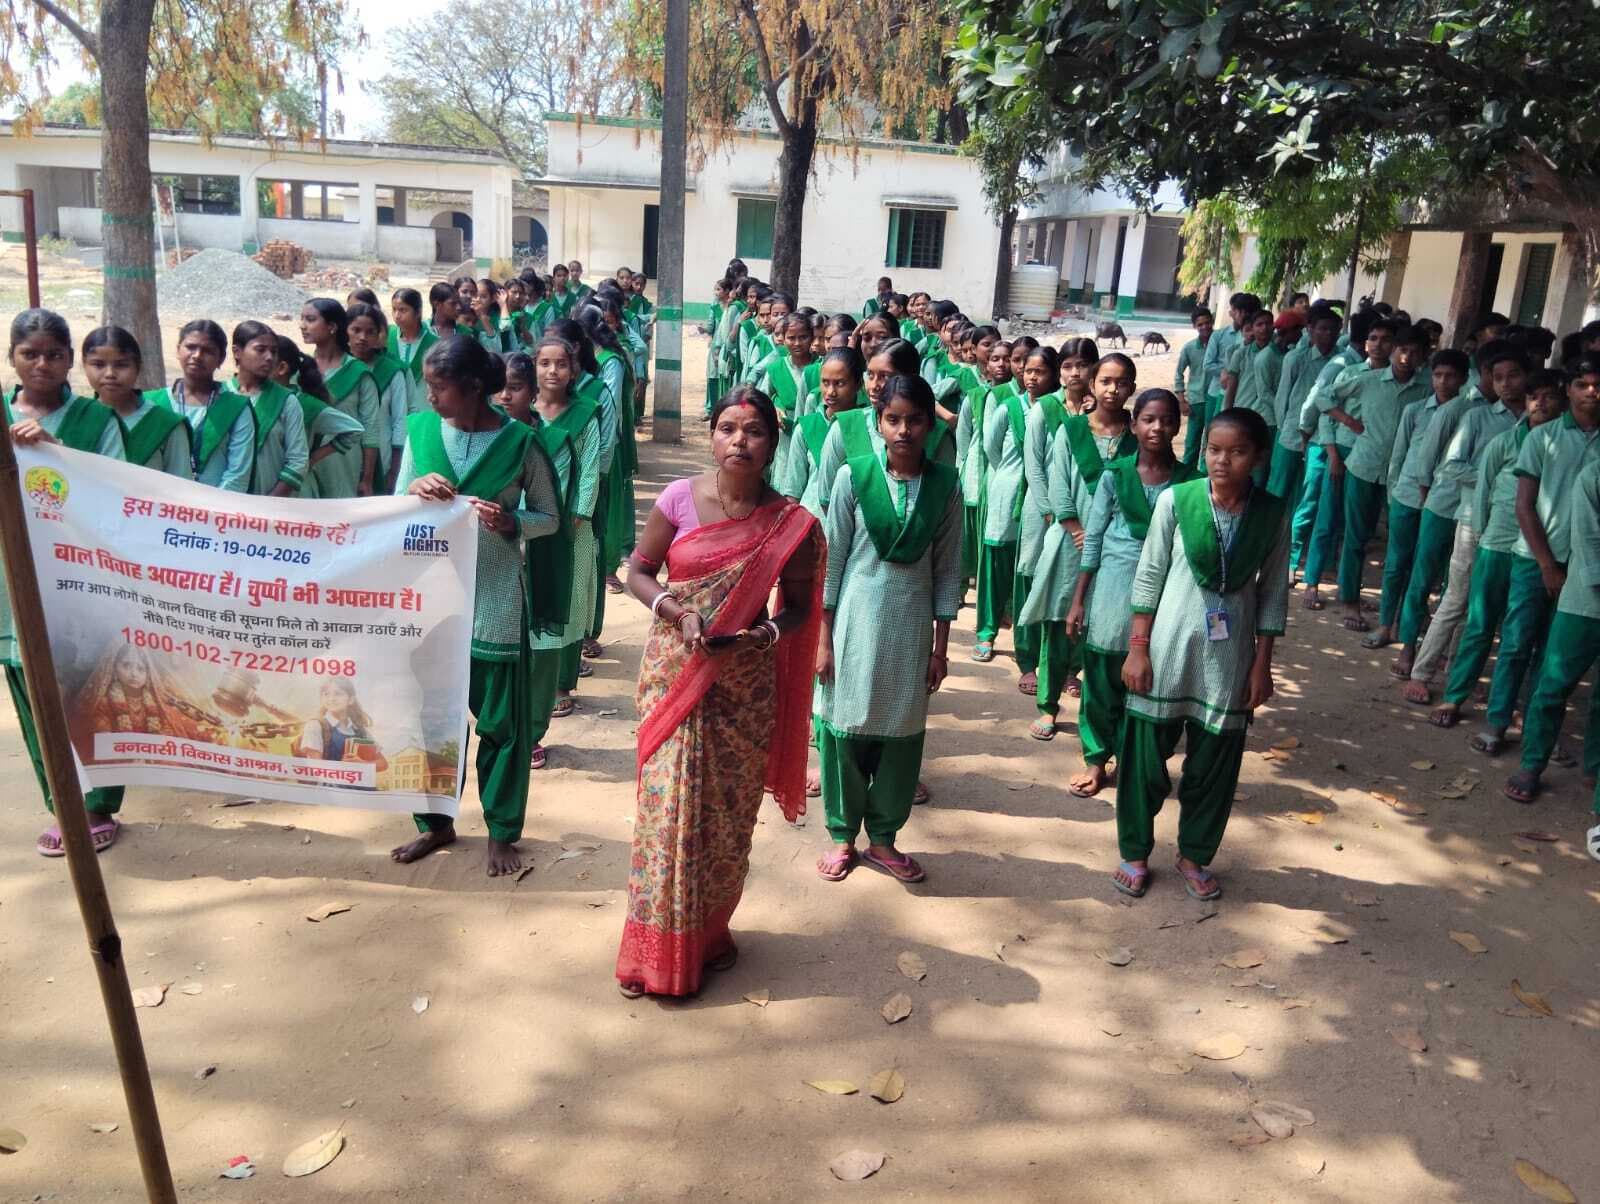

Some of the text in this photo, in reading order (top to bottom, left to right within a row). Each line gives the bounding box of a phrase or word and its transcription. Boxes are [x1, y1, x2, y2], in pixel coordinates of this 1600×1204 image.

[123, 497, 154, 518] इस
[158, 502, 210, 525] अक्षय
[214, 510, 268, 534] तृतीया
[405, 523, 436, 539] JUST
[163, 528, 212, 551] दिनांक
[222, 540, 312, 565] 19-04-2026
[403, 537, 449, 553] RIGHTS
[53, 543, 94, 567] बाल
[96, 548, 144, 580] विवाह
[147, 565, 216, 594] अपराध
[248, 577, 288, 607] चुप्पी
[293, 582, 319, 605] भी
[326, 587, 396, 609] अपराध
[56, 579, 85, 593] अगर
[87, 582, 111, 597] आप
[140, 594, 155, 608] को
[157, 600, 181, 614] बाल
[183, 602, 217, 622] विवाह
[219, 609, 237, 624] की
[239, 613, 273, 630] सूचना
[276, 615, 302, 631] मिले
[305, 618, 319, 632] तो
[322, 622, 363, 634] आवाज
[399, 623, 423, 638] और
[142, 610, 164, 626] नीचे
[166, 615, 186, 631] दिए
[187, 621, 204, 635] गए
[207, 625, 231, 642] नंबर
[233, 630, 249, 644] पर
[251, 632, 276, 649] तुरंत
[279, 635, 308, 649] कॉल
[121, 626, 356, 677] 1800-102-7222/1098
[113, 741, 177, 757] बनवासी
[181, 743, 231, 765] विकास
[292, 764, 363, 784] जामताड़ा
